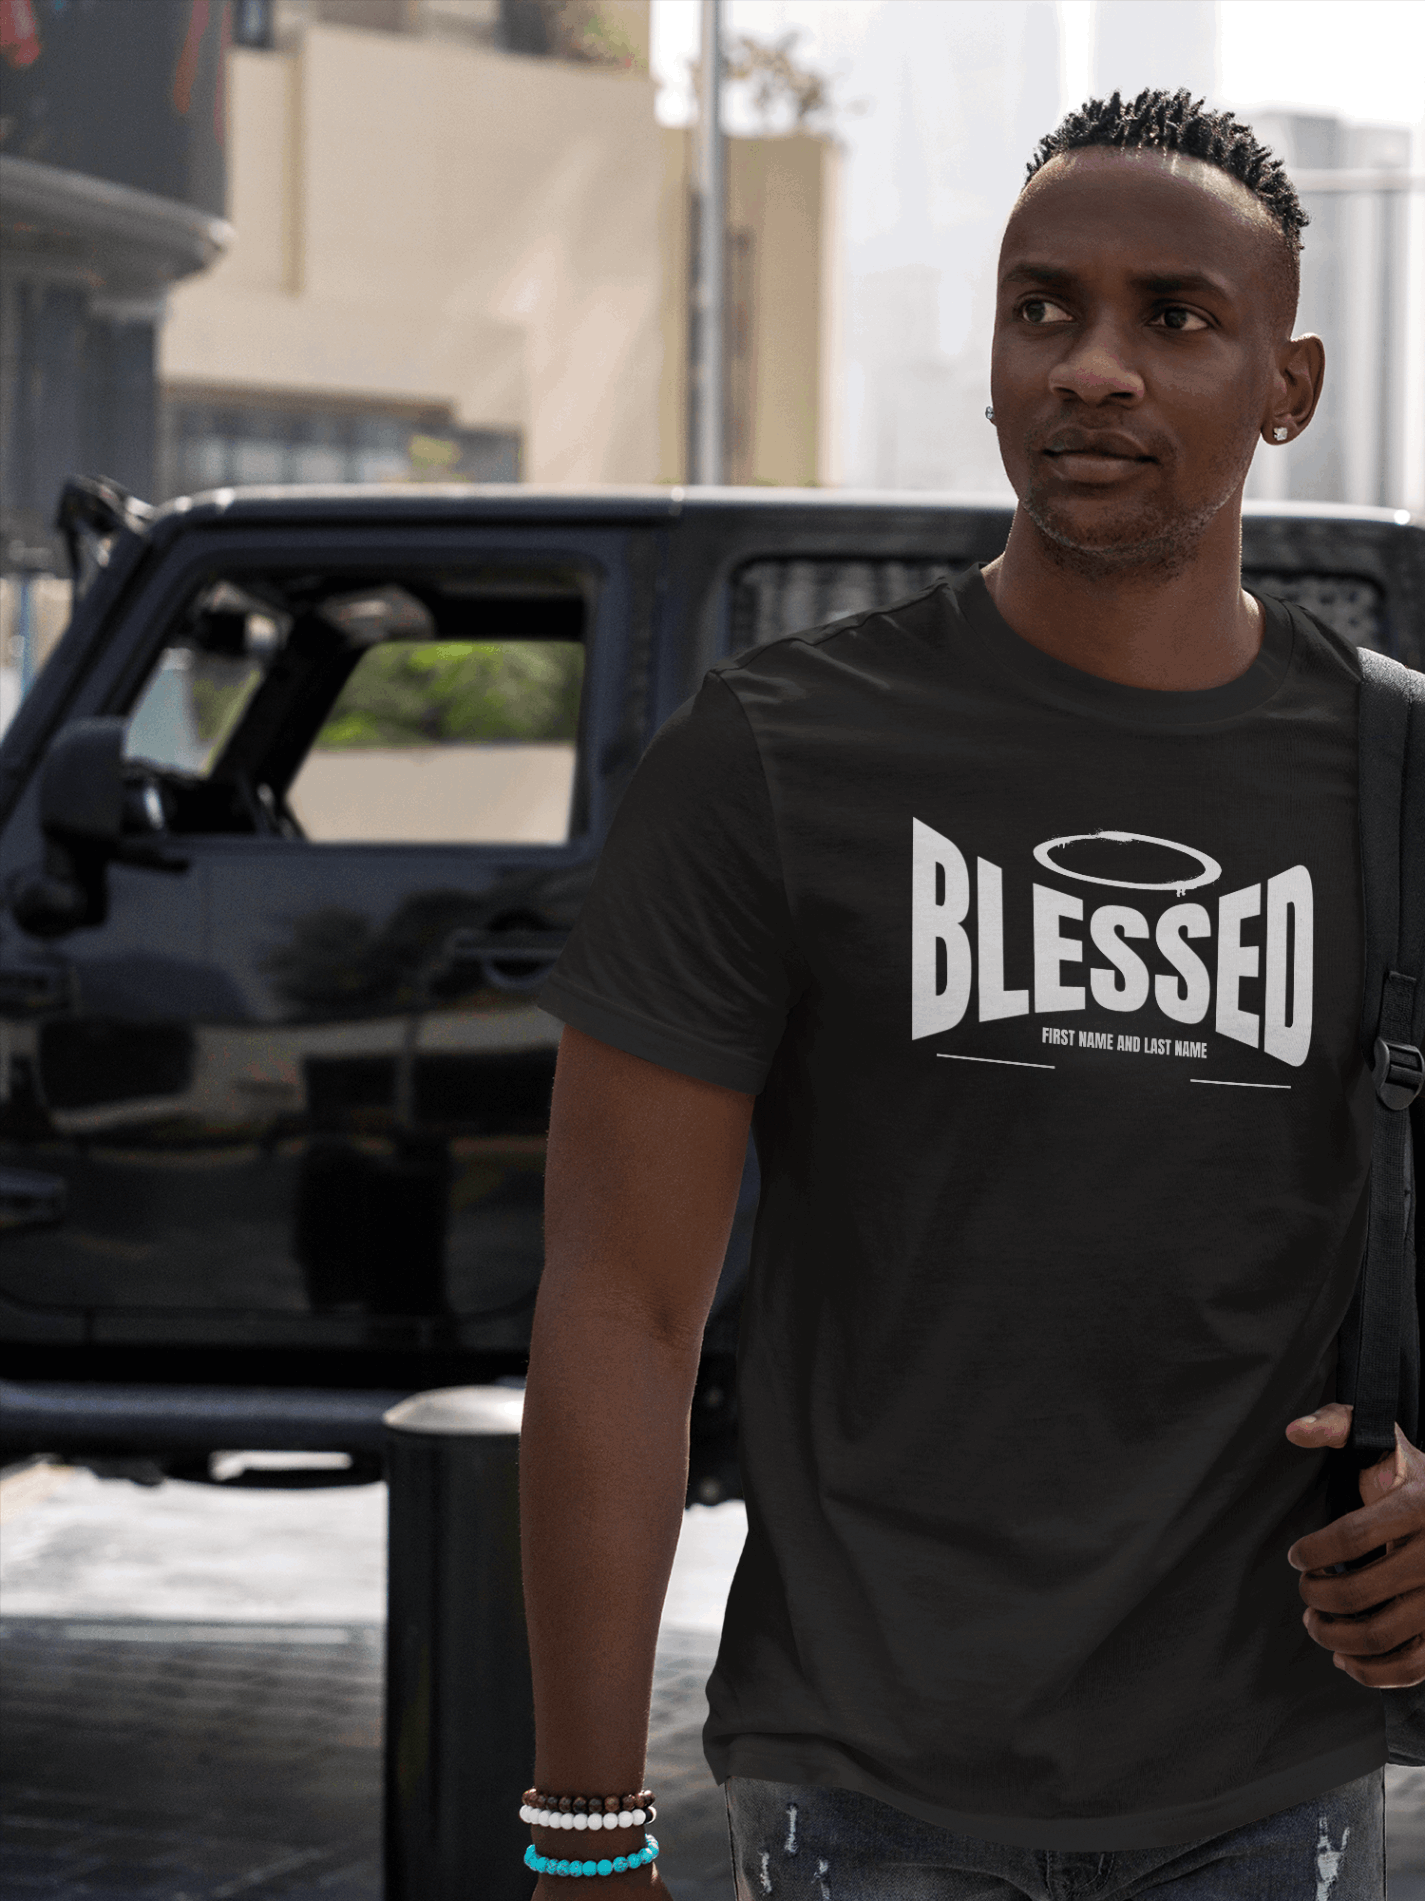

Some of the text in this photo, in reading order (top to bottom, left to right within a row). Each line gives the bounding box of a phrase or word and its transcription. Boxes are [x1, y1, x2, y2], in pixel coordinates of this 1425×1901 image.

[911, 816, 1314, 1067] BLESSED
[1042, 1027, 1208, 1059] FIRST NAME AND LAST NAME
